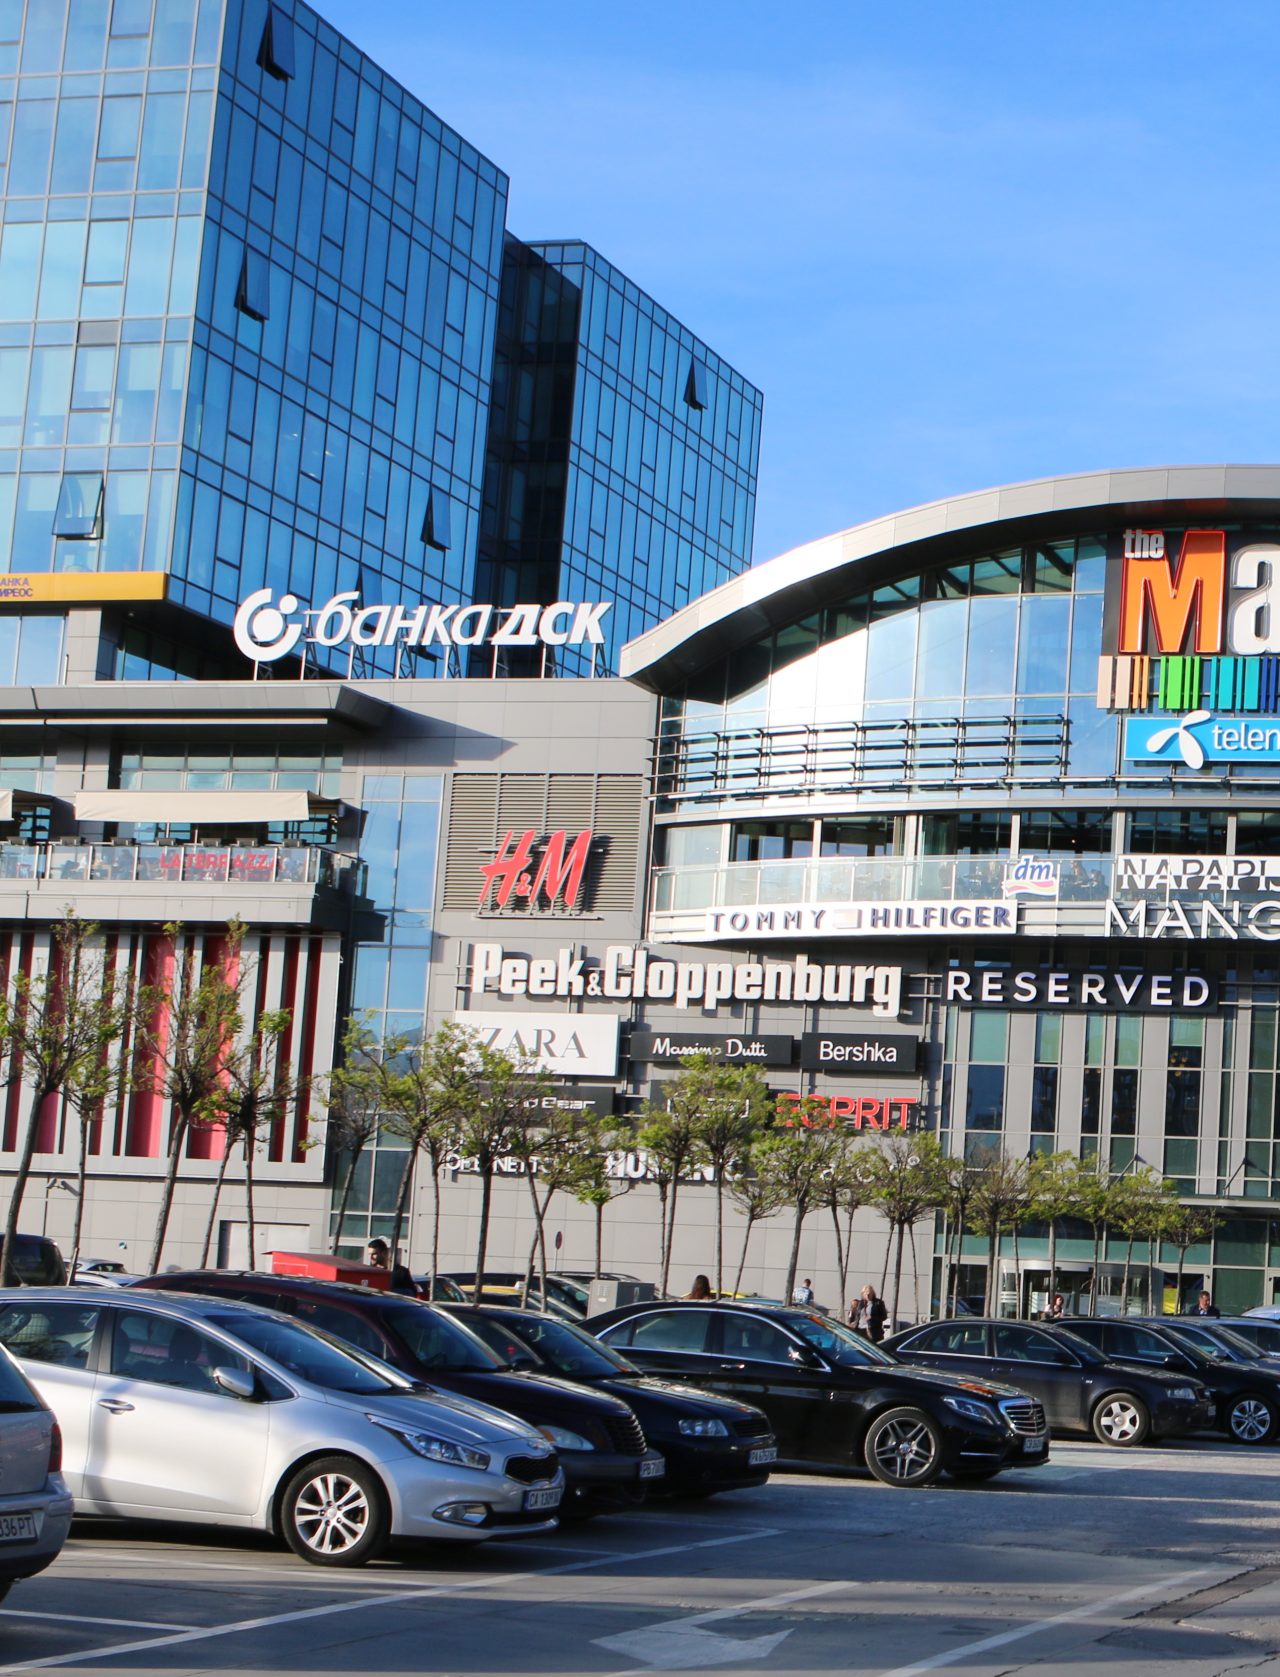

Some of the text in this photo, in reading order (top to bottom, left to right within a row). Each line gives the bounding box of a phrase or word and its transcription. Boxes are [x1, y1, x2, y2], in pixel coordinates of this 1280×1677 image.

[1123, 529, 1165, 559] the
[479, 829, 592, 907] H&M
[1014, 857, 1051, 881] dm
[711, 906, 1012, 932] TOMMY HILFIGER
[946, 969, 1211, 1007] RESERVED
[481, 1028, 589, 1059] ZARA
[652, 1037, 768, 1058] Massimo Dutti
[819, 1040, 897, 1063] Bershka
